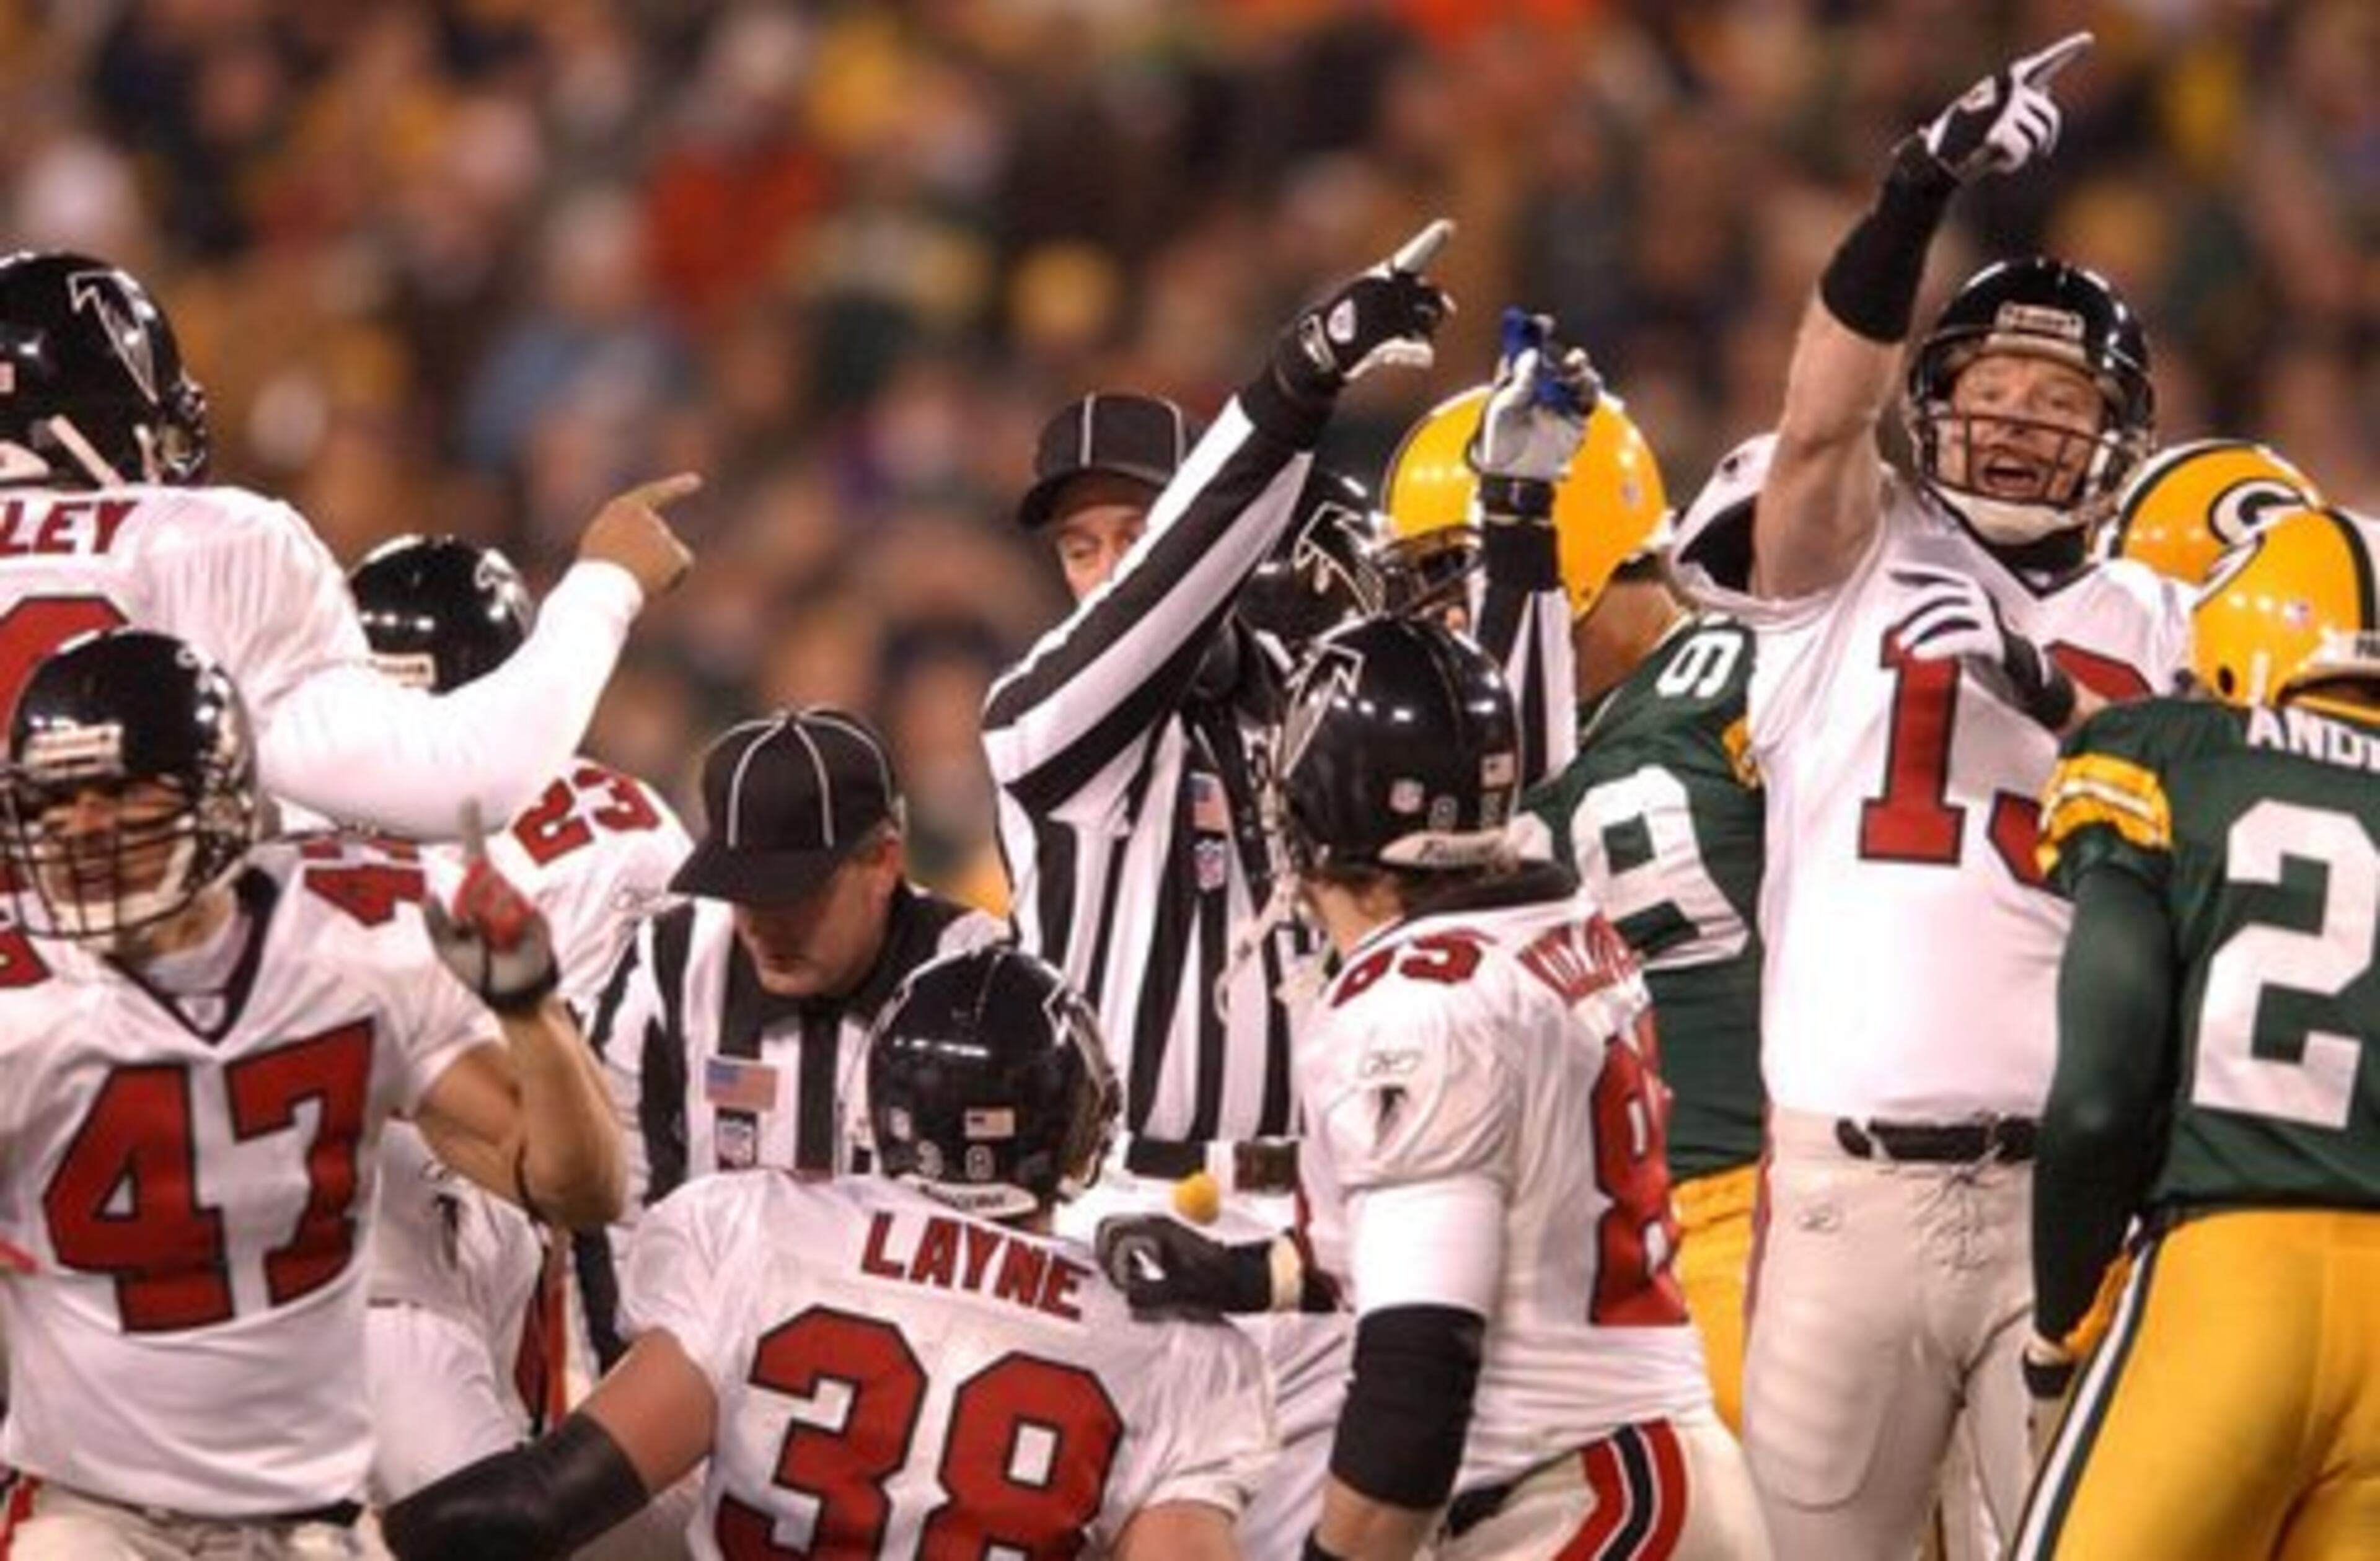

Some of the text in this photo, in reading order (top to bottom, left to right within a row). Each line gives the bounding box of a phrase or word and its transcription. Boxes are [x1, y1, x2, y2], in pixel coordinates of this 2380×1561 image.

[512, 767, 662, 866] 23
[42, 1015, 375, 1333] 47
[860, 1211, 1096, 1322] LAYNE
[713, 1304, 1124, 1561] 38
